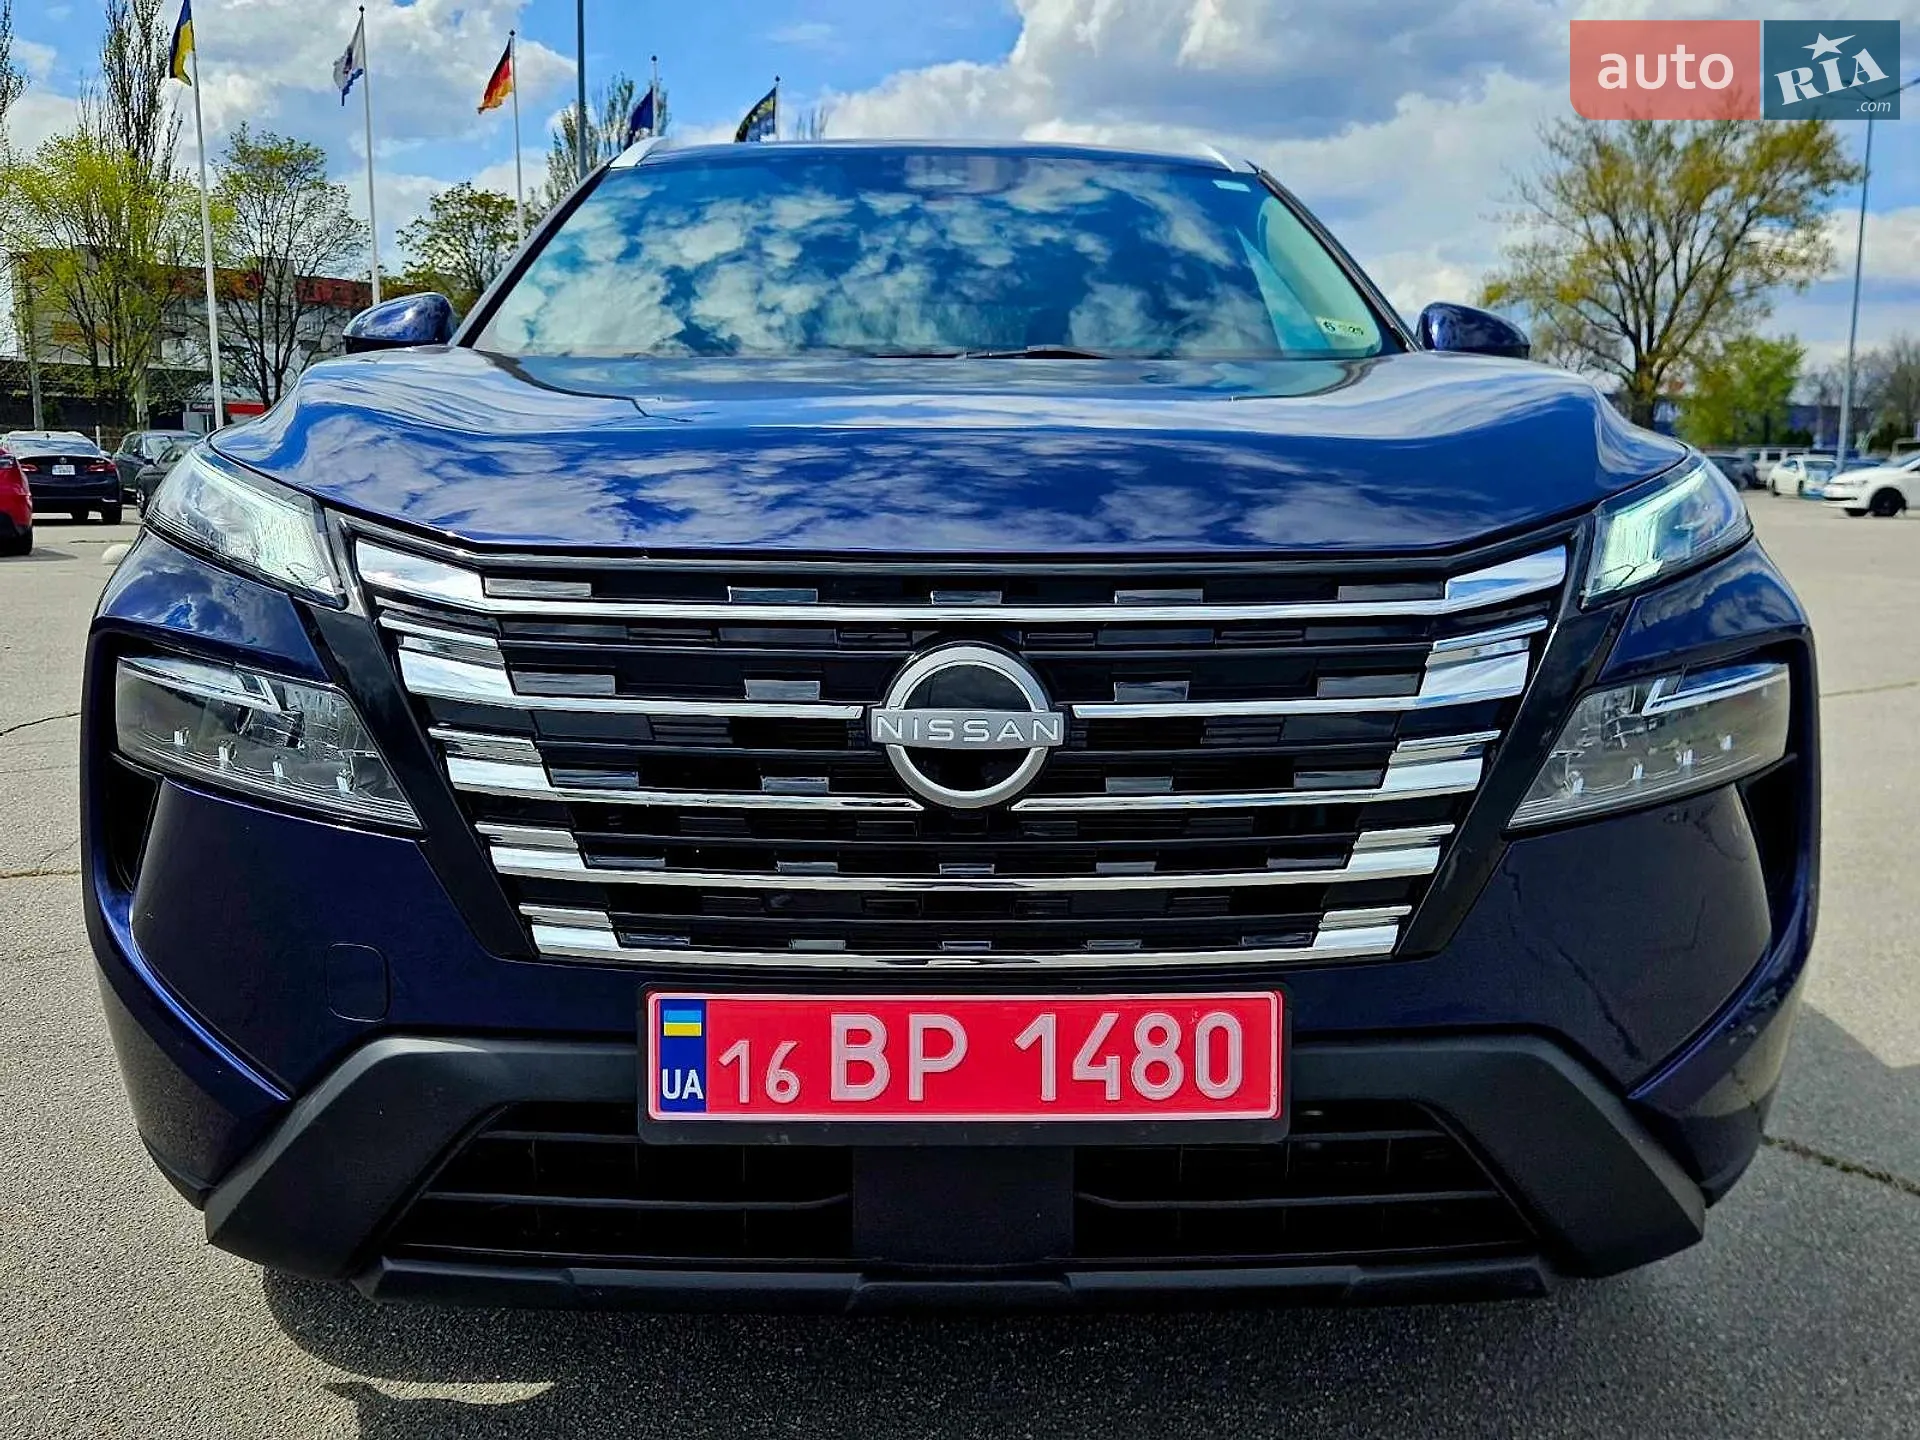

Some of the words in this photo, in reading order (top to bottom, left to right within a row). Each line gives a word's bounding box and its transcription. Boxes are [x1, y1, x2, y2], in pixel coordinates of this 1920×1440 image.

[877, 716, 1059, 742] NISSAN
[718, 1040, 801, 1104] 16
[830, 1013, 968, 1102] BP
[1014, 1012, 1243, 1102] 1480
[662, 1069, 704, 1099] UA
